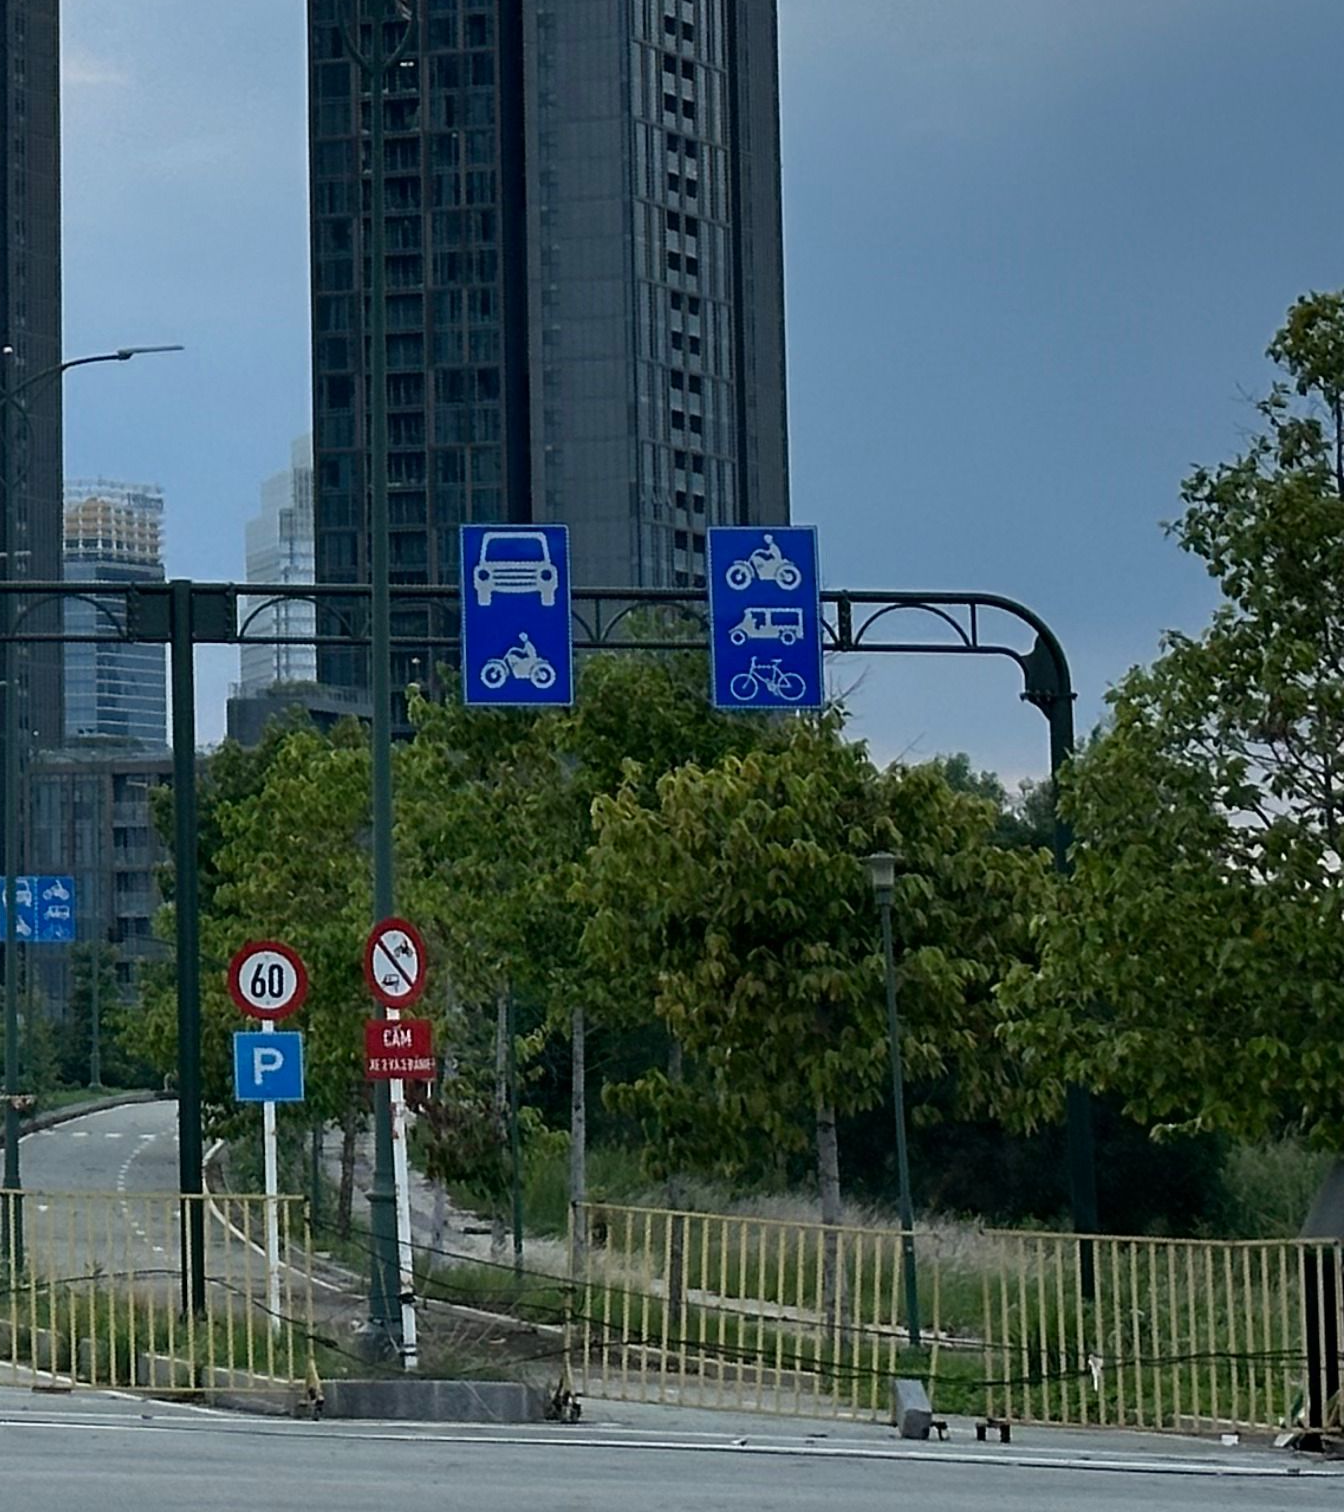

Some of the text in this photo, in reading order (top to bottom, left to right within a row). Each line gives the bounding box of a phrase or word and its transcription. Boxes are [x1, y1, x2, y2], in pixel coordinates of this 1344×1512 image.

[251, 963, 284, 998] 60
[383, 1024, 413, 1047] CẤM
[253, 1047, 284, 1085] P
